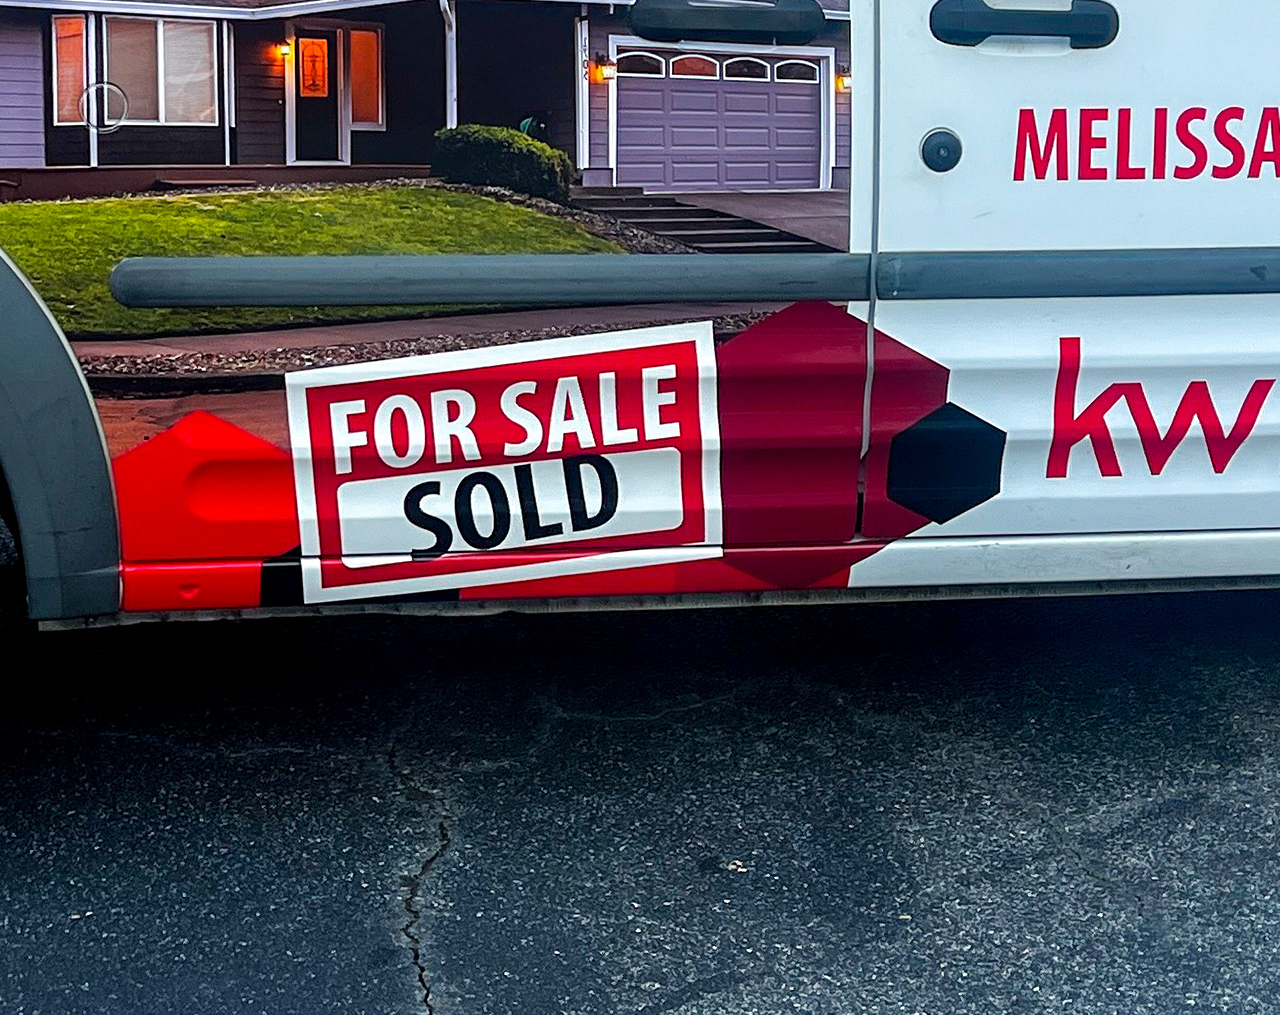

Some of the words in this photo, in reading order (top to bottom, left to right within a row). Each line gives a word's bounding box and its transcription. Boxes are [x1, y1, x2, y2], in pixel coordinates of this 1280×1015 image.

[329, 389, 482, 475] FOR
[499, 363, 681, 457] SALE
[1045, 337, 1276, 479] kw
[402, 454, 620, 561] SOLD
